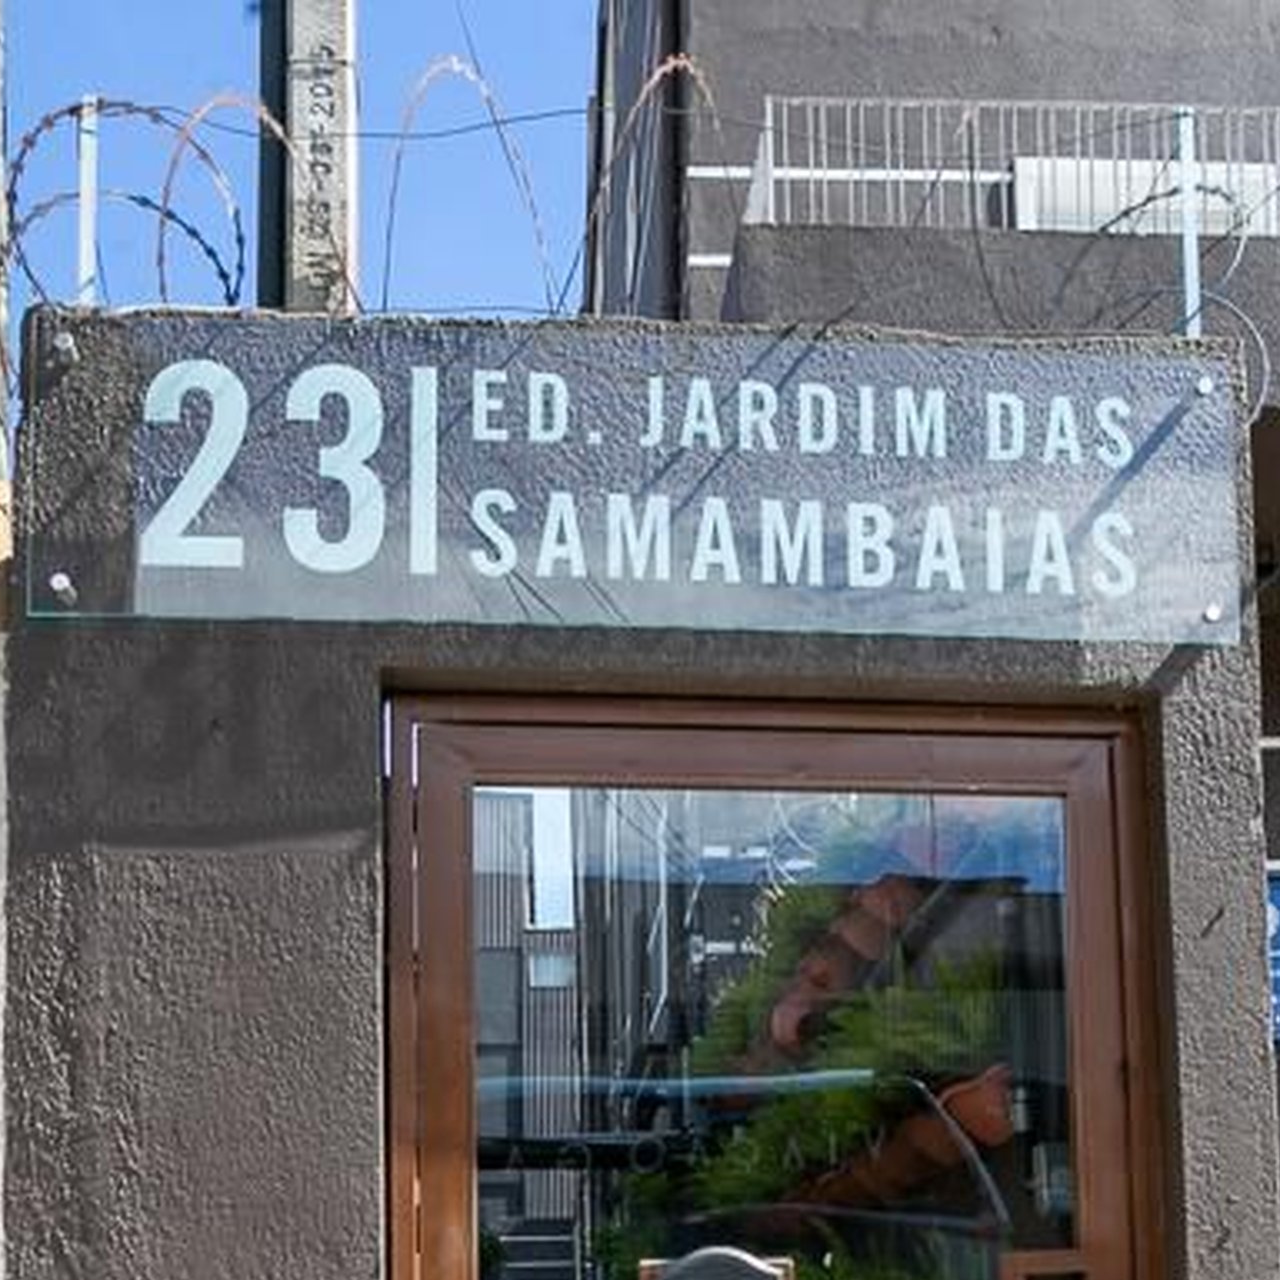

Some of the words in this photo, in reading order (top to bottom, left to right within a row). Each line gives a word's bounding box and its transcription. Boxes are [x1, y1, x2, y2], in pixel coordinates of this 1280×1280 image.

[470, 369, 602, 445] ED.
[640, 376, 949, 459] JARDIM
[986, 390, 1134, 470] DAS
[468, 487, 1138, 599] SAMAMBAIAS
